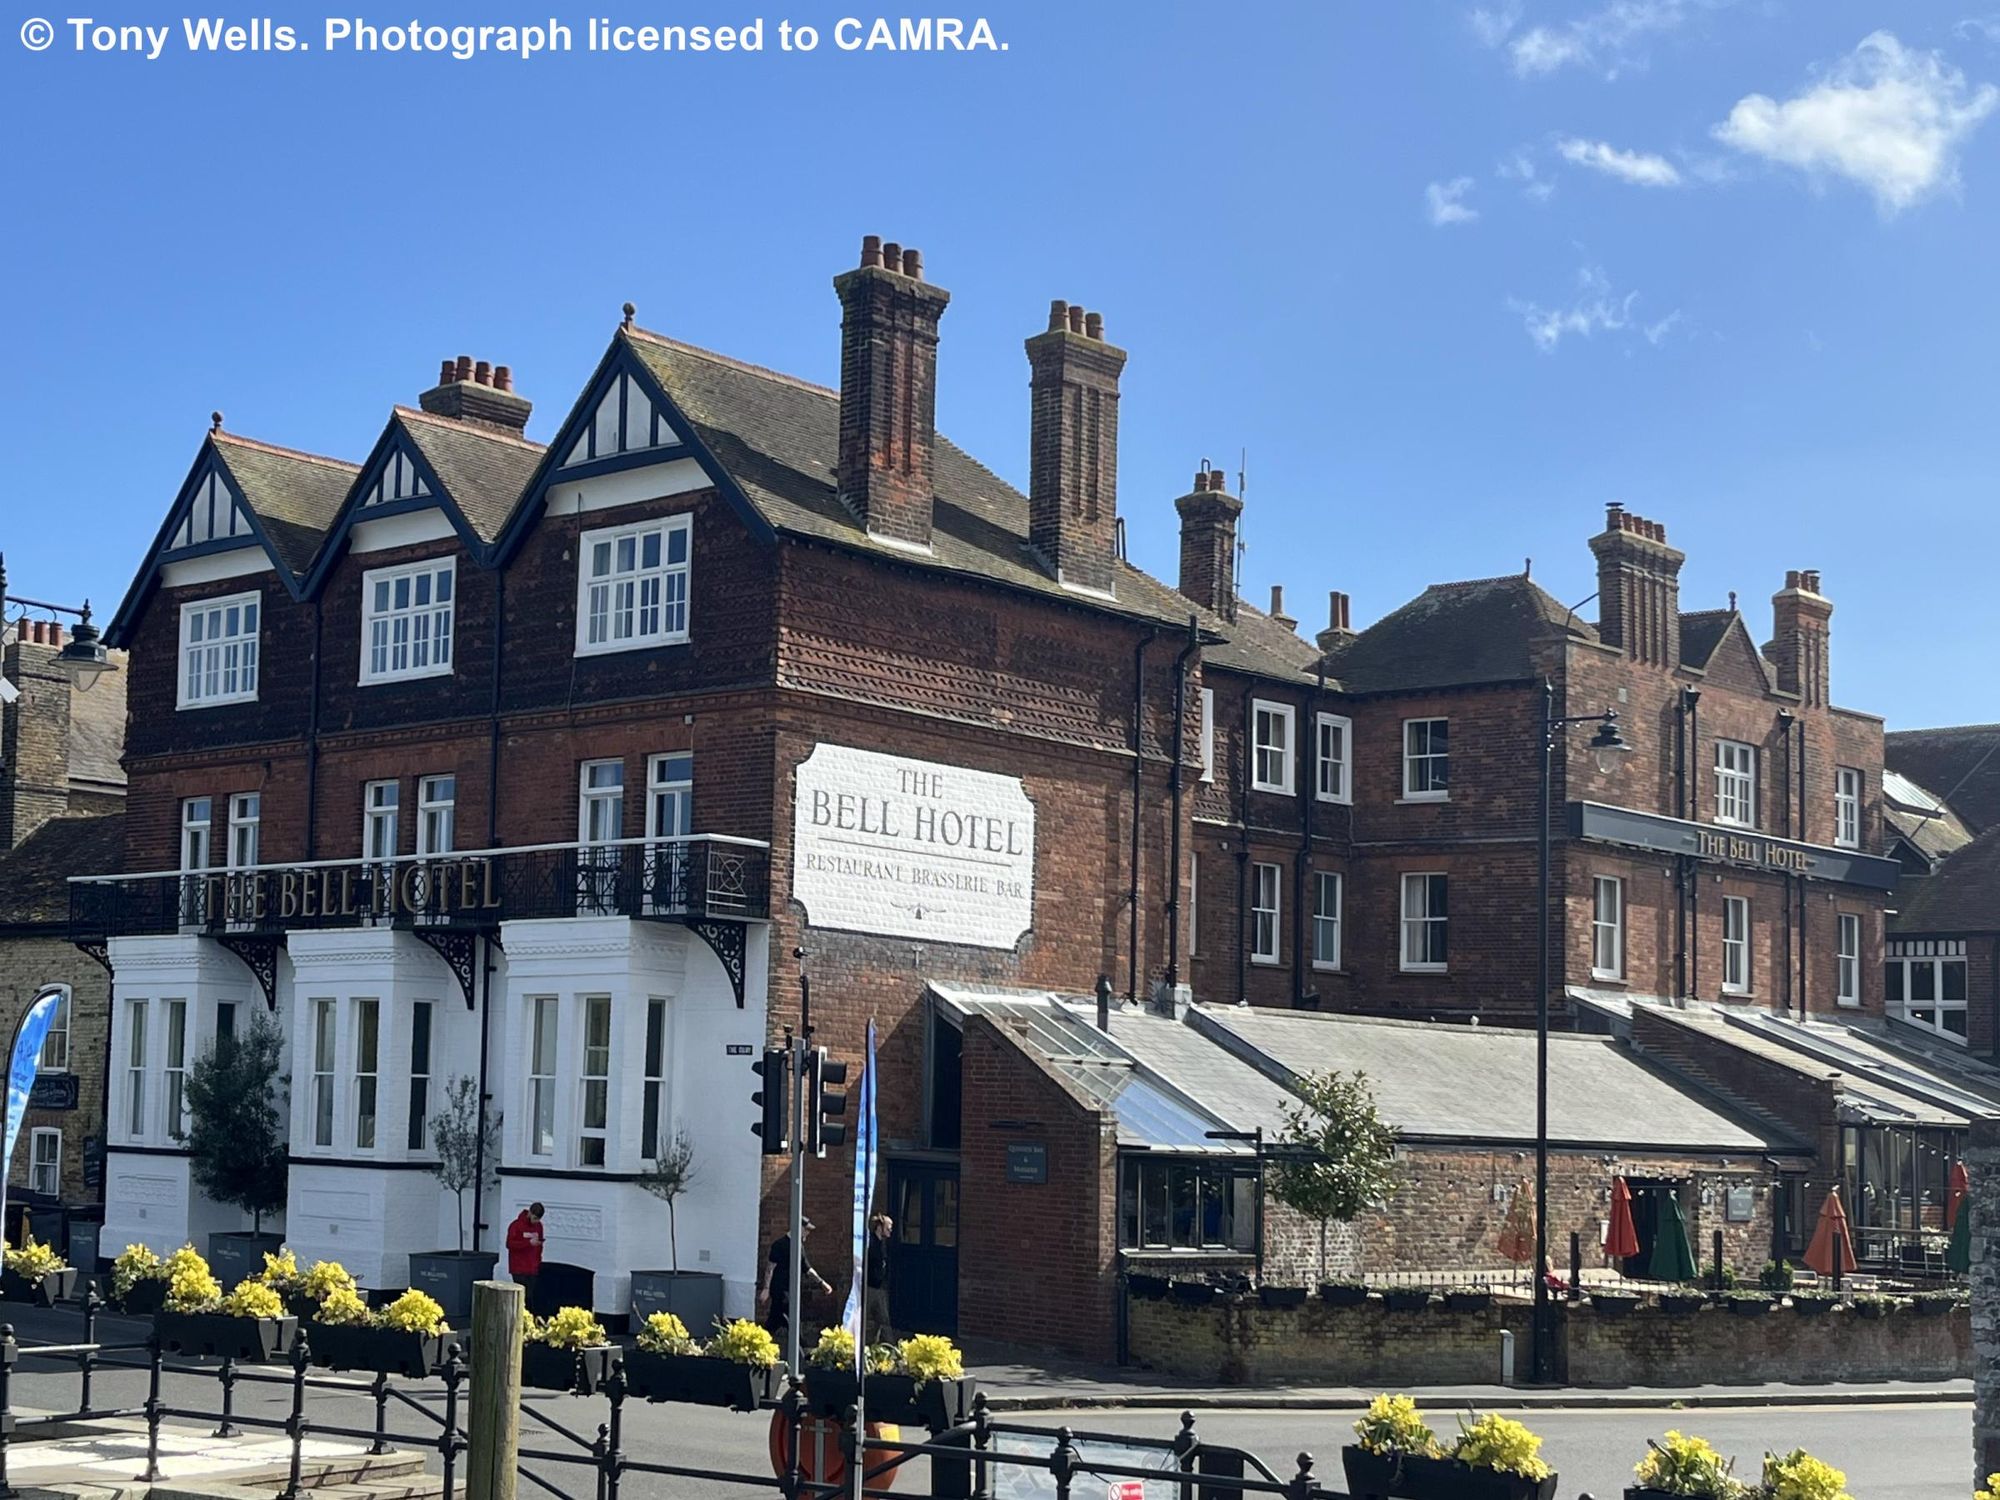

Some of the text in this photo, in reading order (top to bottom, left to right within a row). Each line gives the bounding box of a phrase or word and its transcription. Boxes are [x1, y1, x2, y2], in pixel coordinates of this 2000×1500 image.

[896, 768, 944, 799] THE
[811, 789, 1023, 856] BELL HOTEL
[1697, 830, 1809, 871] THE BELL HOTEL
[204, 859, 502, 921] THE BELL HOTEL
[806, 853, 1024, 899] RESTAURANT BRASSERIE BAR
